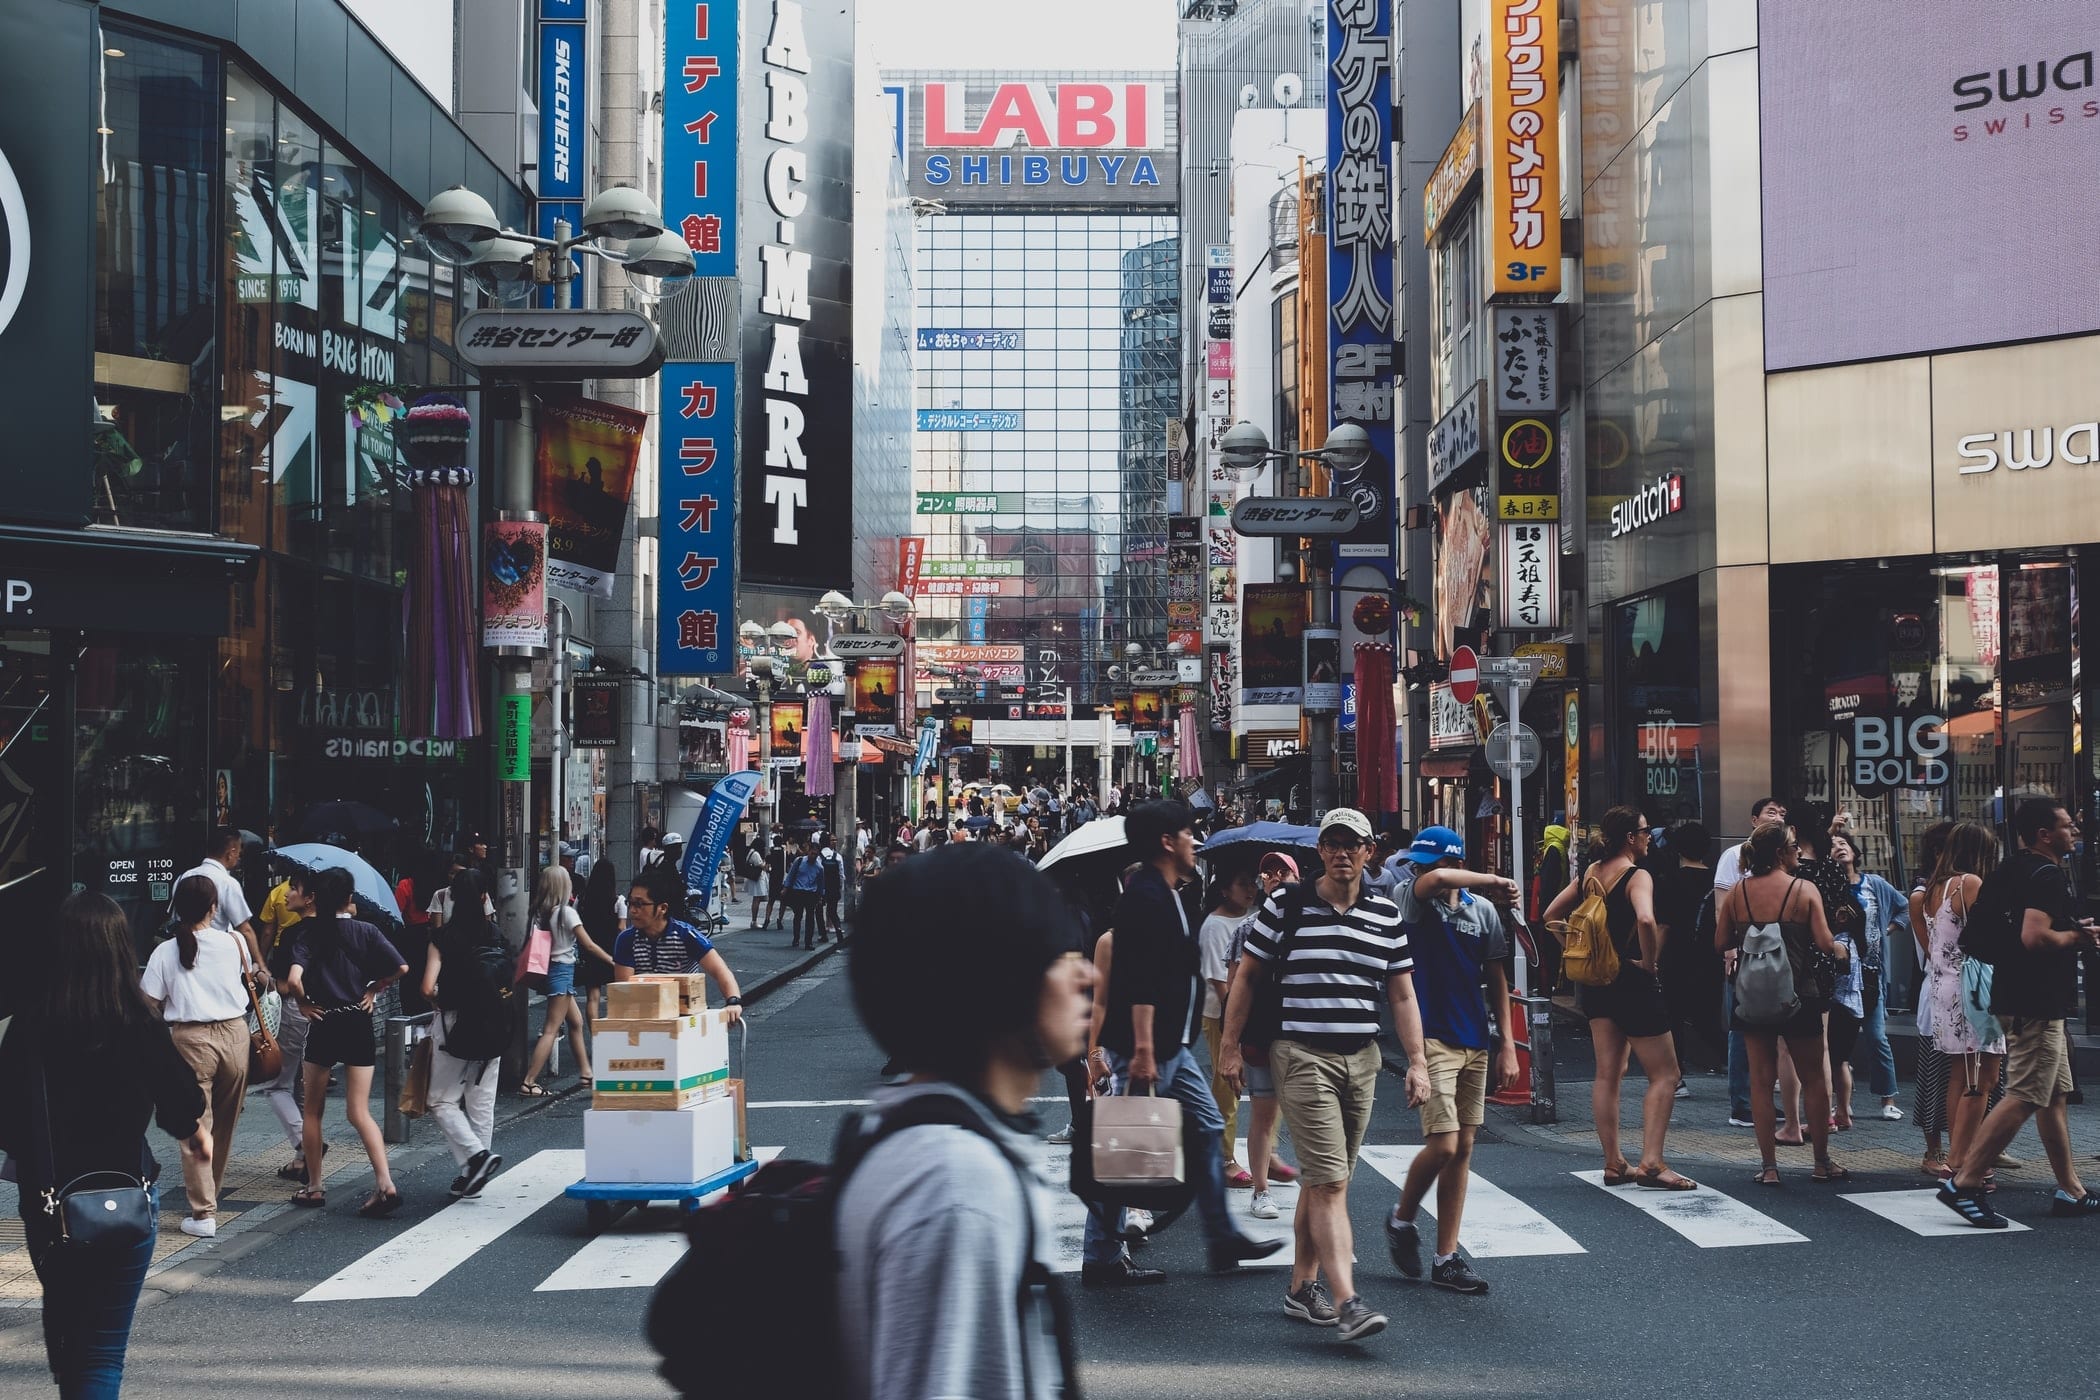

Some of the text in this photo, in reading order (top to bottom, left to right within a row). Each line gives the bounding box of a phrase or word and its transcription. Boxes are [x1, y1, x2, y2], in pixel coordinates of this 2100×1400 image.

[1953, 51, 2093, 113] swa
[555, 38, 571, 184] SKECHERS
[924, 83, 1147, 147] LABI
[1953, 100, 2099, 142] SWISS
[924, 154, 1161, 186] SHIBUYA
[1506, 262, 1547, 281] 3F
[238, 279, 299, 298] SINCE 1976
[466, 326, 645, 349] 渋谷センター街
[918, 333, 1018, 348] ム・おもちゃ・オーディオ
[275, 322, 394, 384] BORN IN BRIGHTON
[1336, 344, 1392, 376] 2F
[1335, 381, 1393, 421] 受付
[363, 407, 384, 433] OVED
[361, 433, 392, 458] IN TOKYO
[1957, 422, 2100, 475] swa
[1512, 473, 1542, 489] そば
[677, 380, 719, 650] カラオケ館
[1241, 507, 1353, 522] 渋谷センター街
[1503, 499, 1553, 517] 春日亭
[1611, 476, 1670, 538] swatch
[548, 515, 612, 541] イオン・キング
[552, 538, 574, 551] 8.9
[1211, 556, 1223, 564] 2F
[548, 565, 600, 585] センター街
[1516, 542, 1542, 625] 元祖寿司
[833, 640, 899, 649] 渋谷センター街
[505, 700, 519, 775] 客引きは犯罪です
[1646, 718, 1677, 765] BIG
[1854, 715, 1949, 758] BIG
[1646, 768, 1678, 794] BOLD
[1855, 759, 1949, 785] BOLD
[109, 859, 173, 869] OPEN 11:00
[109, 872, 173, 882] CLOSE 21:30
[1456, 918, 1481, 938] IGER
